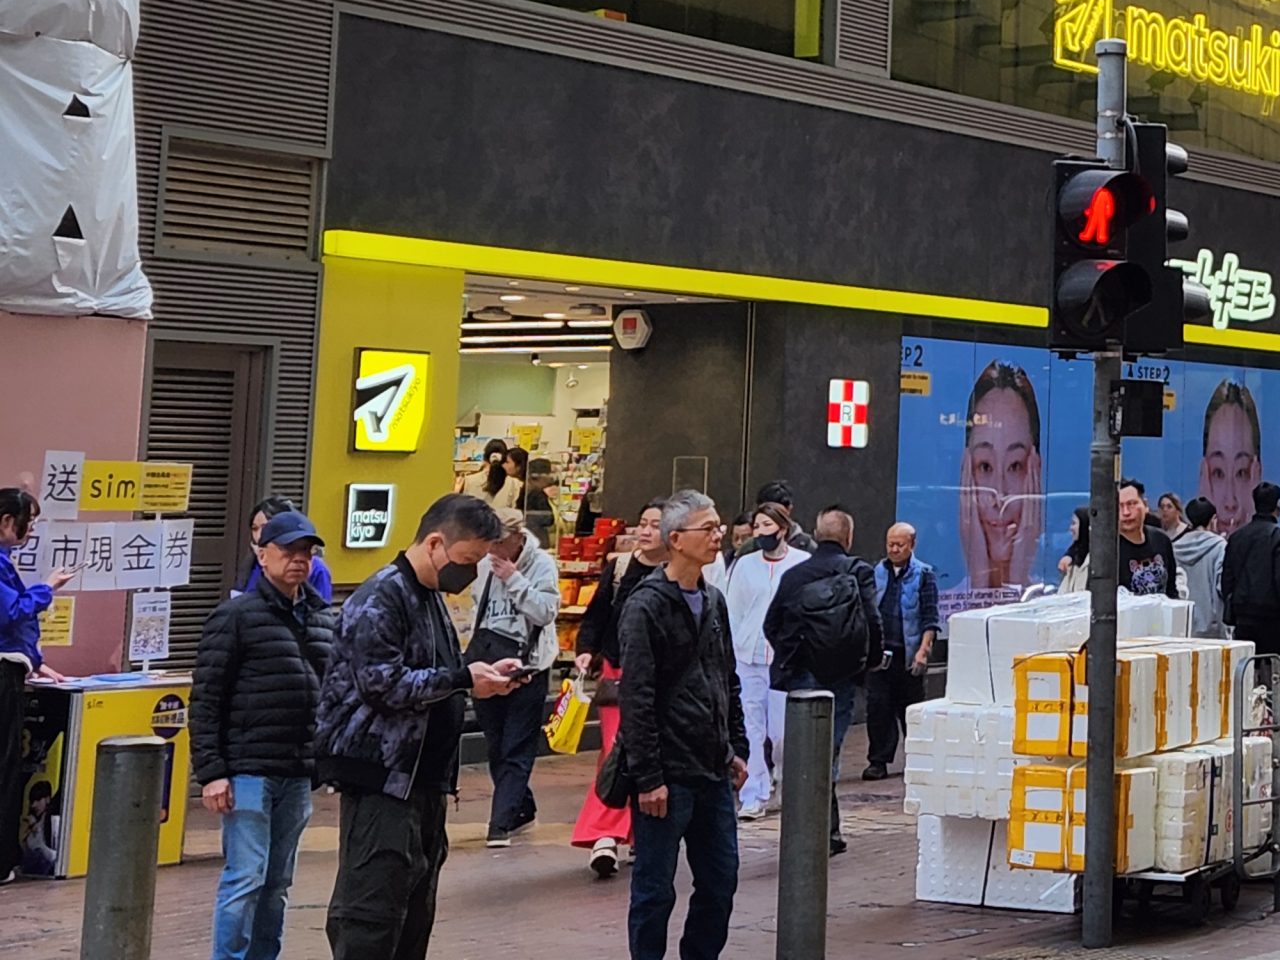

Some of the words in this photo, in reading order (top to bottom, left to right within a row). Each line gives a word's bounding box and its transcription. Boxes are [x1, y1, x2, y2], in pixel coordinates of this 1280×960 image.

[913, 345, 923, 367] 2
[1137, 367, 1162, 380] STEP
[44, 464, 78, 502] 送
[90, 473, 135, 499] sim
[351, 508, 388, 524] matsu
[350, 522, 376, 544] kiyo
